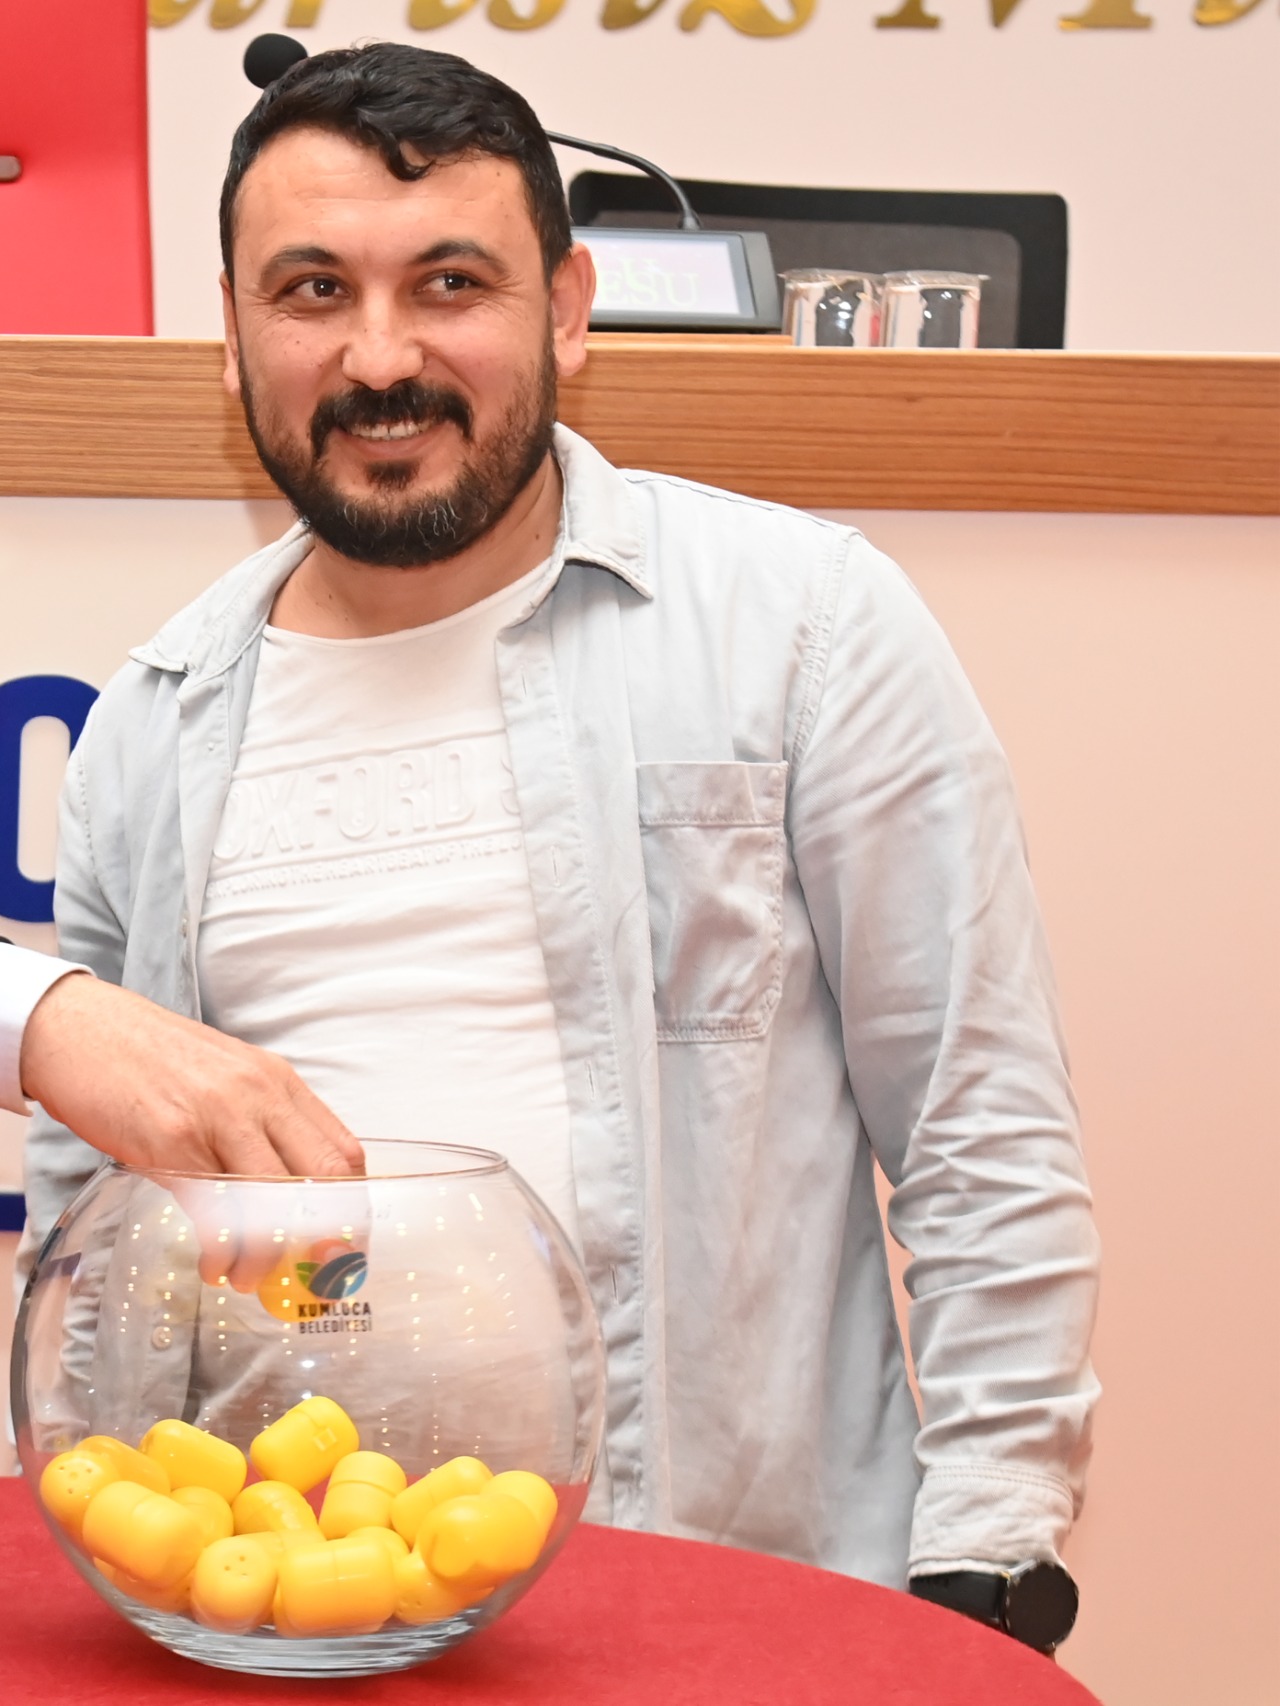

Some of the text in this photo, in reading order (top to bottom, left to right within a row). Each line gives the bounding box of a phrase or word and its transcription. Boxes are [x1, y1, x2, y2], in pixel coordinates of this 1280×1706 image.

[212, 741, 478, 861] OXFORD
[298, 1302, 372, 1317] KUMLUCA
[299, 1317, 373, 1334] BELEDİYESİ
